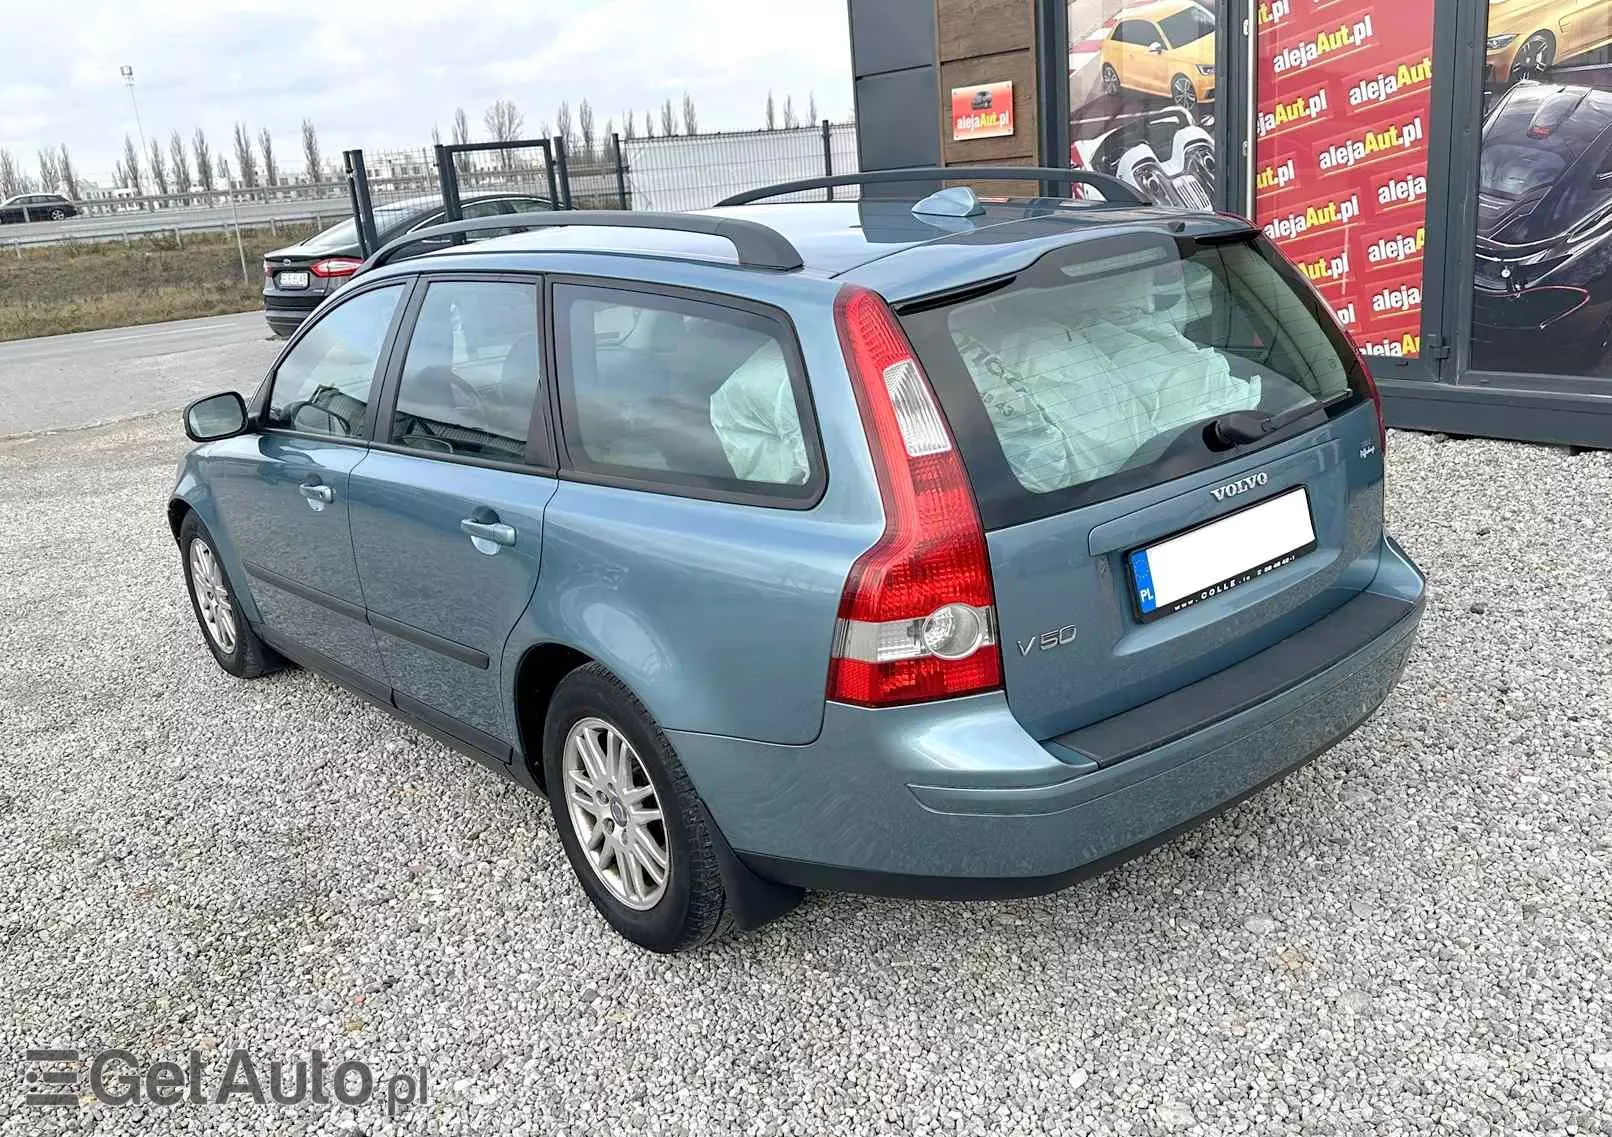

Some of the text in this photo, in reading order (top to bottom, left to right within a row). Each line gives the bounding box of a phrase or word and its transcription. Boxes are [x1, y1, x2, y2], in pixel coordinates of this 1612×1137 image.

[1273, 15, 1373, 73] alejaAut.pl
[957, 109, 1009, 132] alejaAut.pl
[1319, 117, 1424, 170] alejaAut.pl
[1378, 174, 1427, 205] aleja
[1263, 195, 1360, 240] alejaAut.pl
[1372, 285, 1421, 312] aleja
[1210, 472, 1268, 501] VOLVO
[1139, 588, 1154, 603] PL
